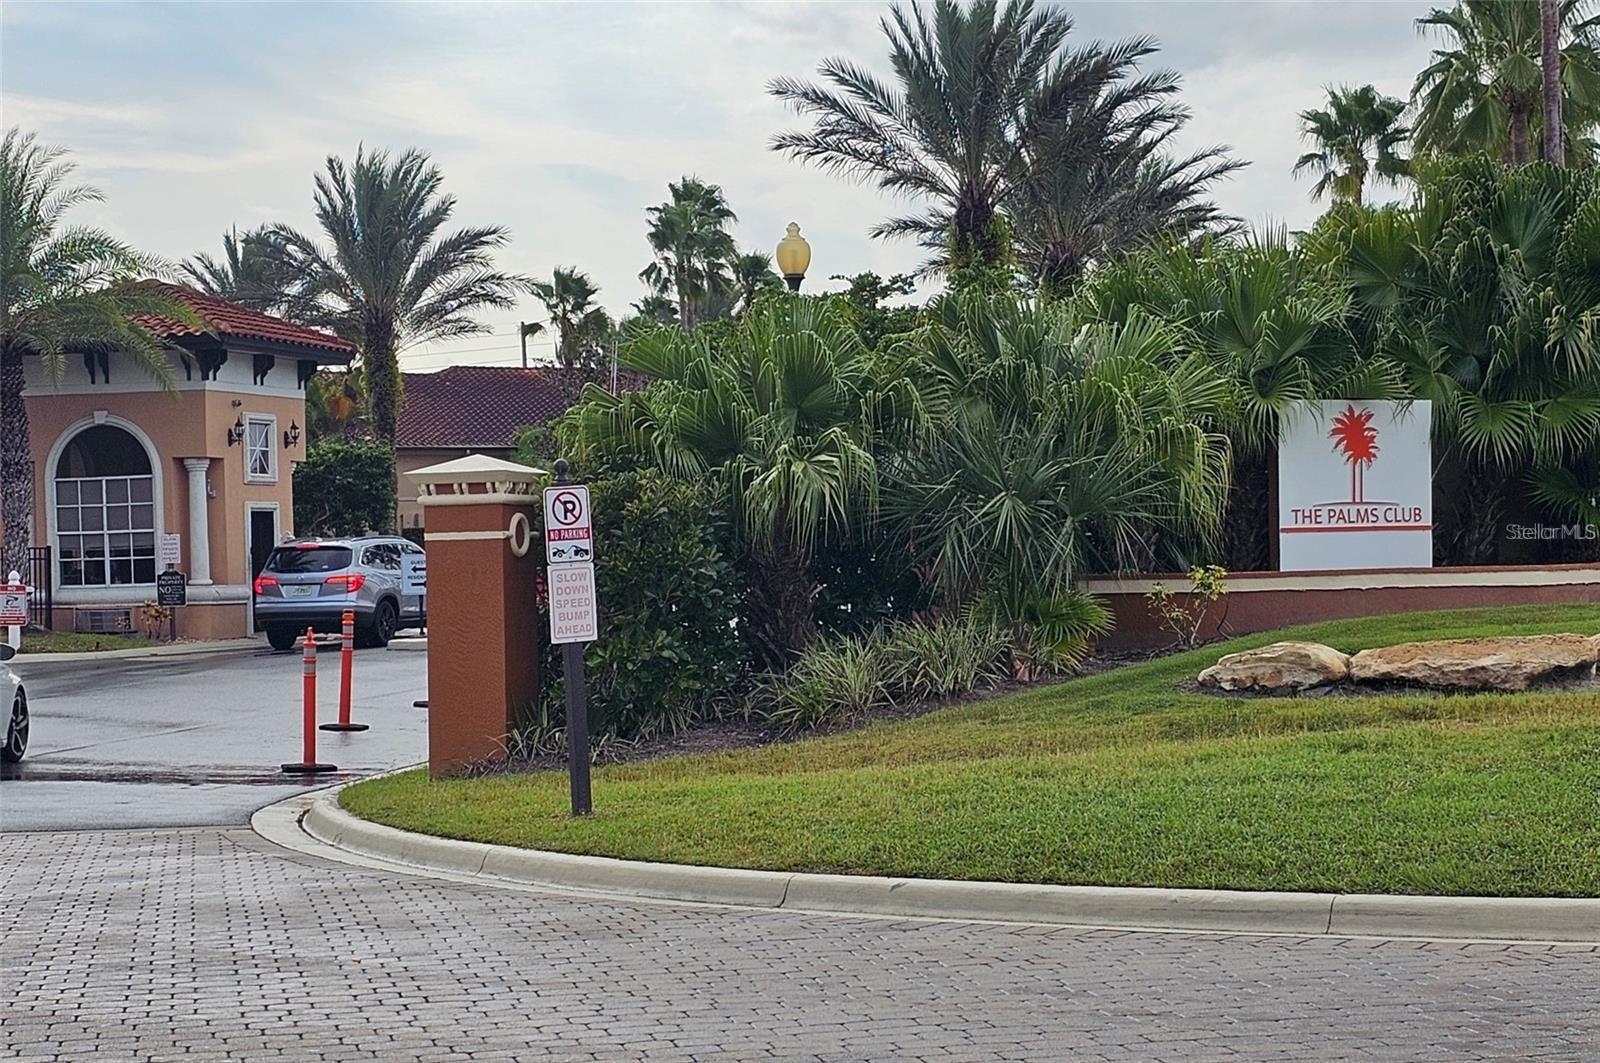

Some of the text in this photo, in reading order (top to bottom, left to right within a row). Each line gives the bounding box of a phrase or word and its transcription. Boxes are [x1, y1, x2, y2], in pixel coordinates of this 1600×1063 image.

[1291, 506, 1423, 525] THE PALMS CLUB
[549, 528, 588, 541] NO PARKING
[556, 572, 588, 583] SLOW
[159, 586, 172, 594] NO
[556, 584, 589, 596] DOWN
[556, 597, 591, 609] SPEED
[558, 611, 590, 622] BUMP
[557, 623, 592, 636] AHEAD
